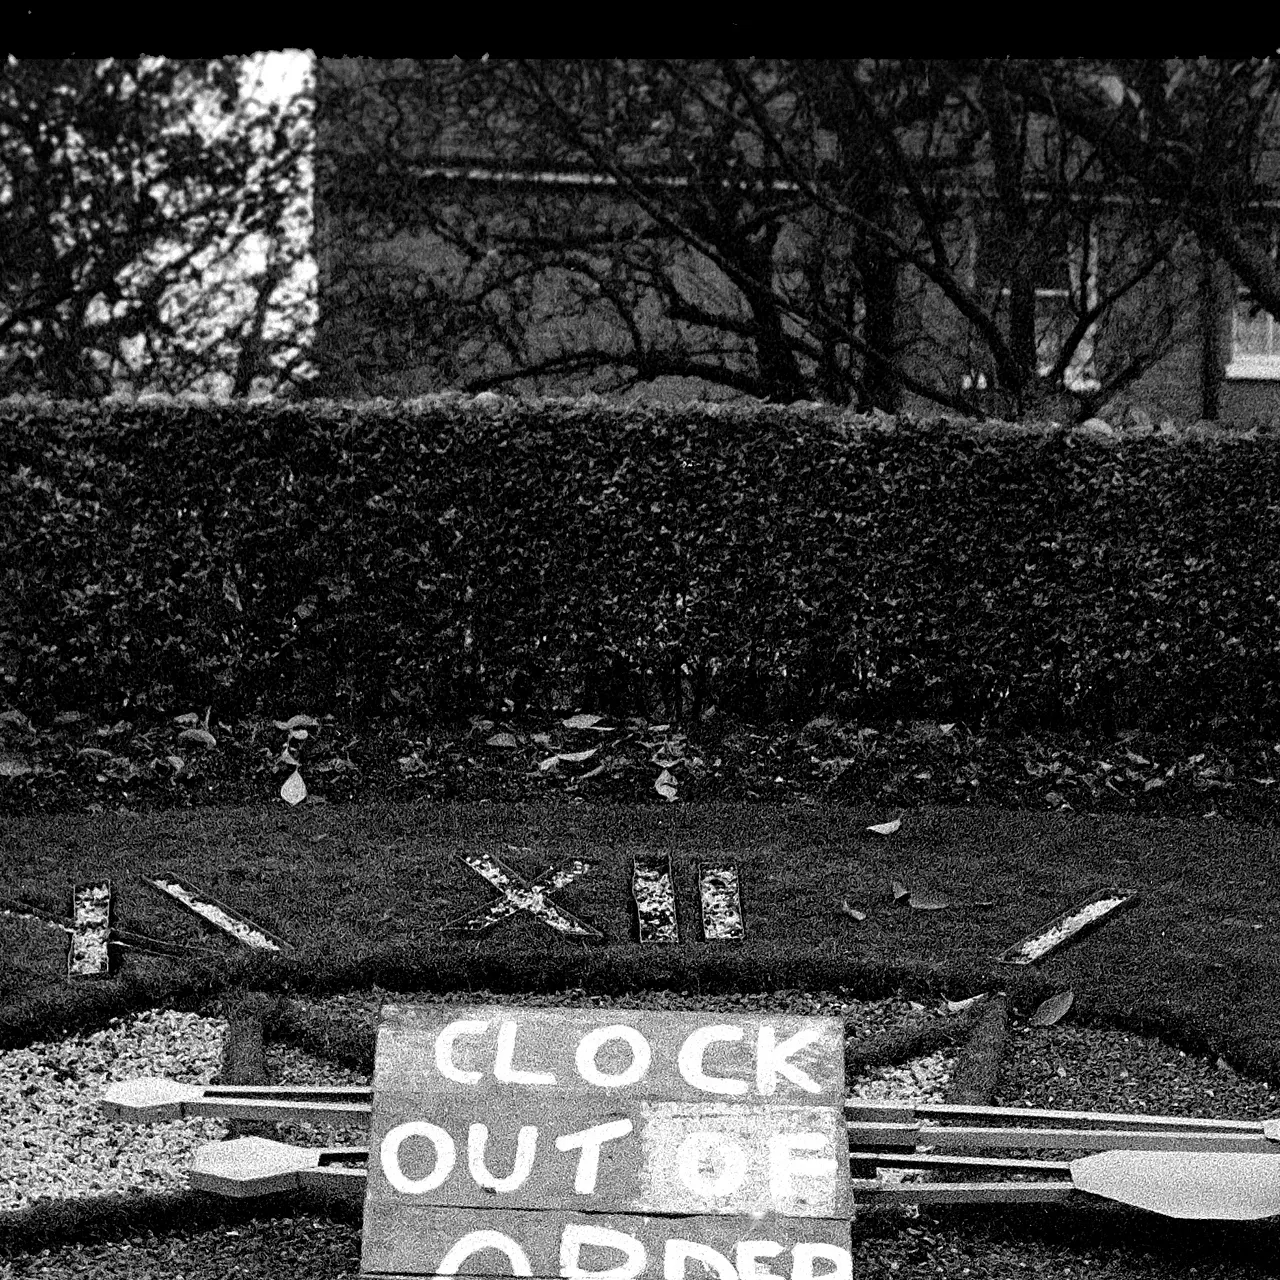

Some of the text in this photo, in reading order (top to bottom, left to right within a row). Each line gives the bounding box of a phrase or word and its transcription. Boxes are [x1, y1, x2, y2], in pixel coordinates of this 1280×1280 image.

[438, 852, 746, 943] XII
[434, 1019, 823, 1096] CLOCK
[380, 1118, 839, 1198] OUT OF
